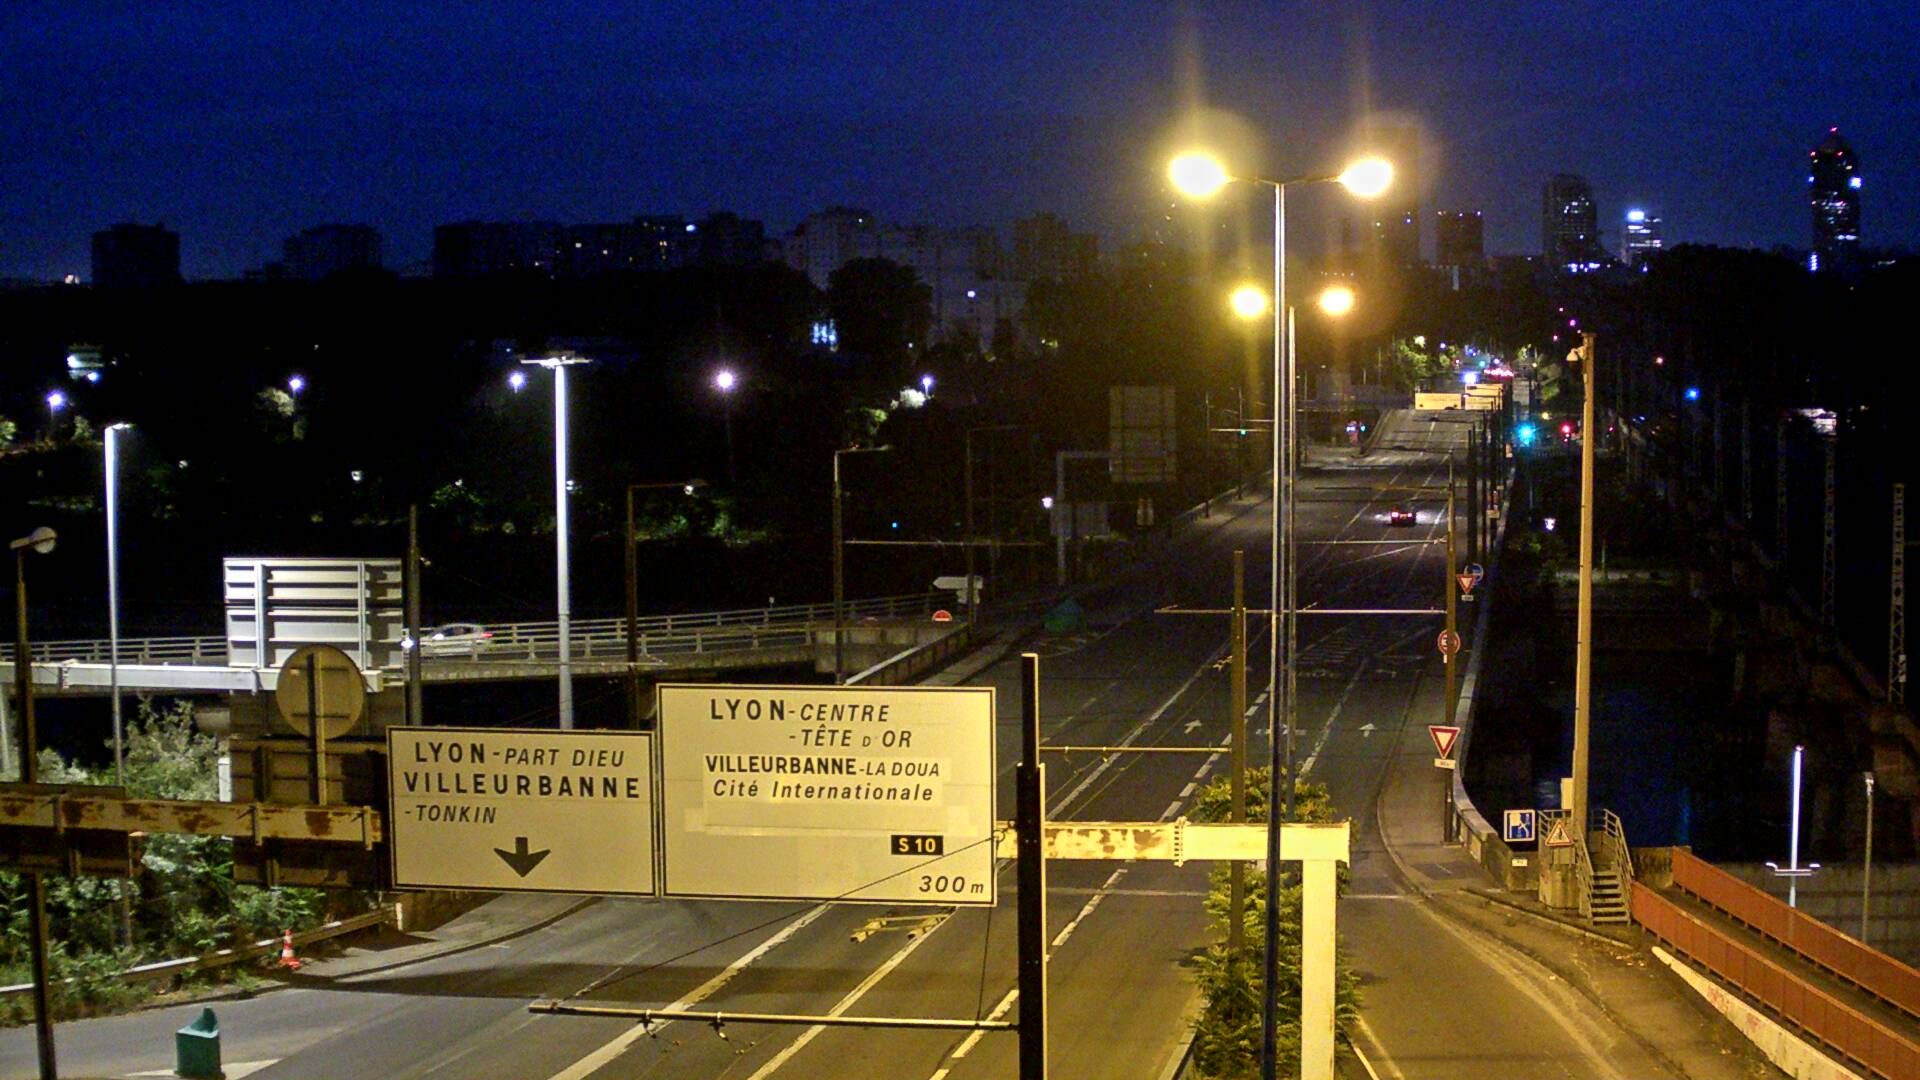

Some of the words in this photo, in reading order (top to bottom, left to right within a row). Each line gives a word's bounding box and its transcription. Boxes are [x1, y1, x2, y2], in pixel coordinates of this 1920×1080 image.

[572, 748, 625, 768] DIEU
[891, 761, 940, 777] DOUA
[403, 771, 640, 799] VILLEURBANNE
[713, 778, 759, 797] Cité
[772, 780, 933, 801] Internationale
[898, 837, 910, 853] S
[914, 838, 937, 853] 10
[919, 875, 966, 893] 300
[970, 882, 985, 893] m
